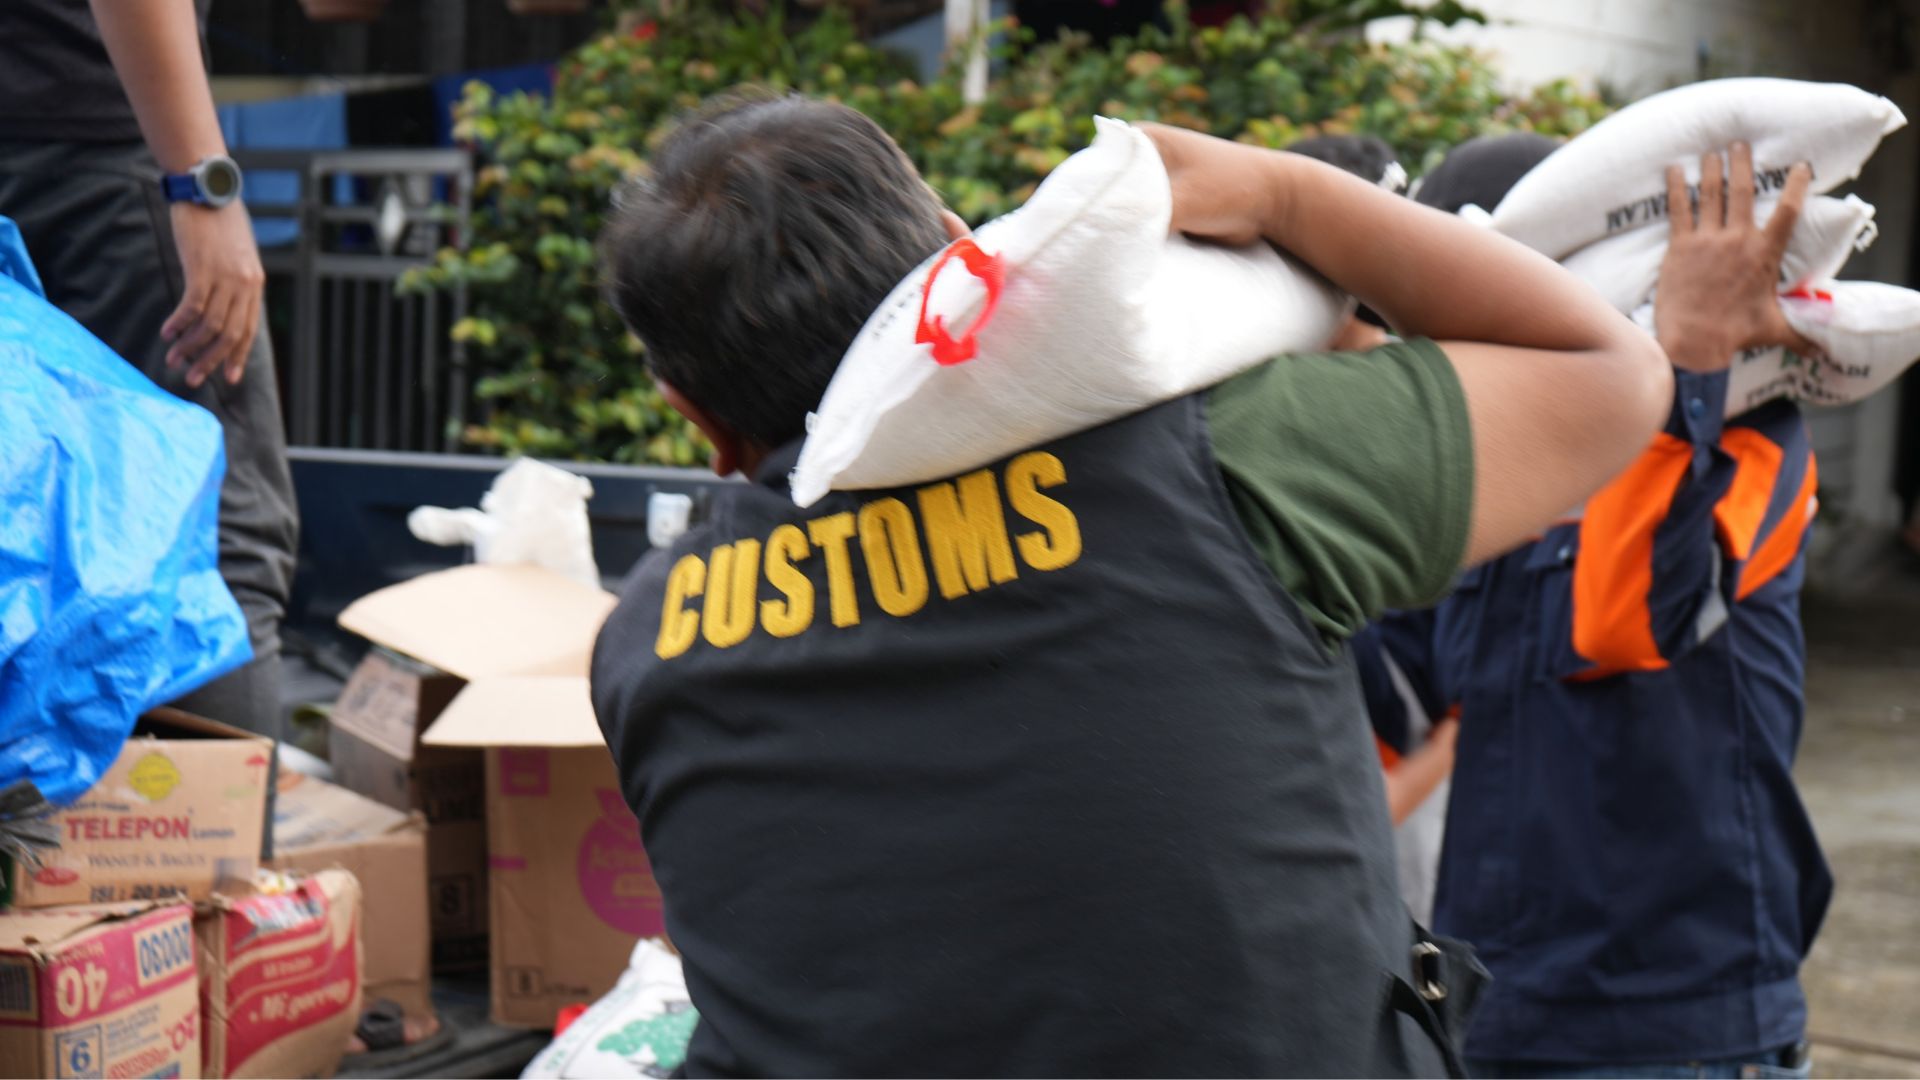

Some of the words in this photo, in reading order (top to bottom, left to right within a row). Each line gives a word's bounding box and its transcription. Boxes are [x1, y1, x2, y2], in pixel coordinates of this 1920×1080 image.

[654, 451, 1083, 660] CUSTOMS
[65, 816, 190, 840] TELEPON
[54, 961, 109, 1019] 40
